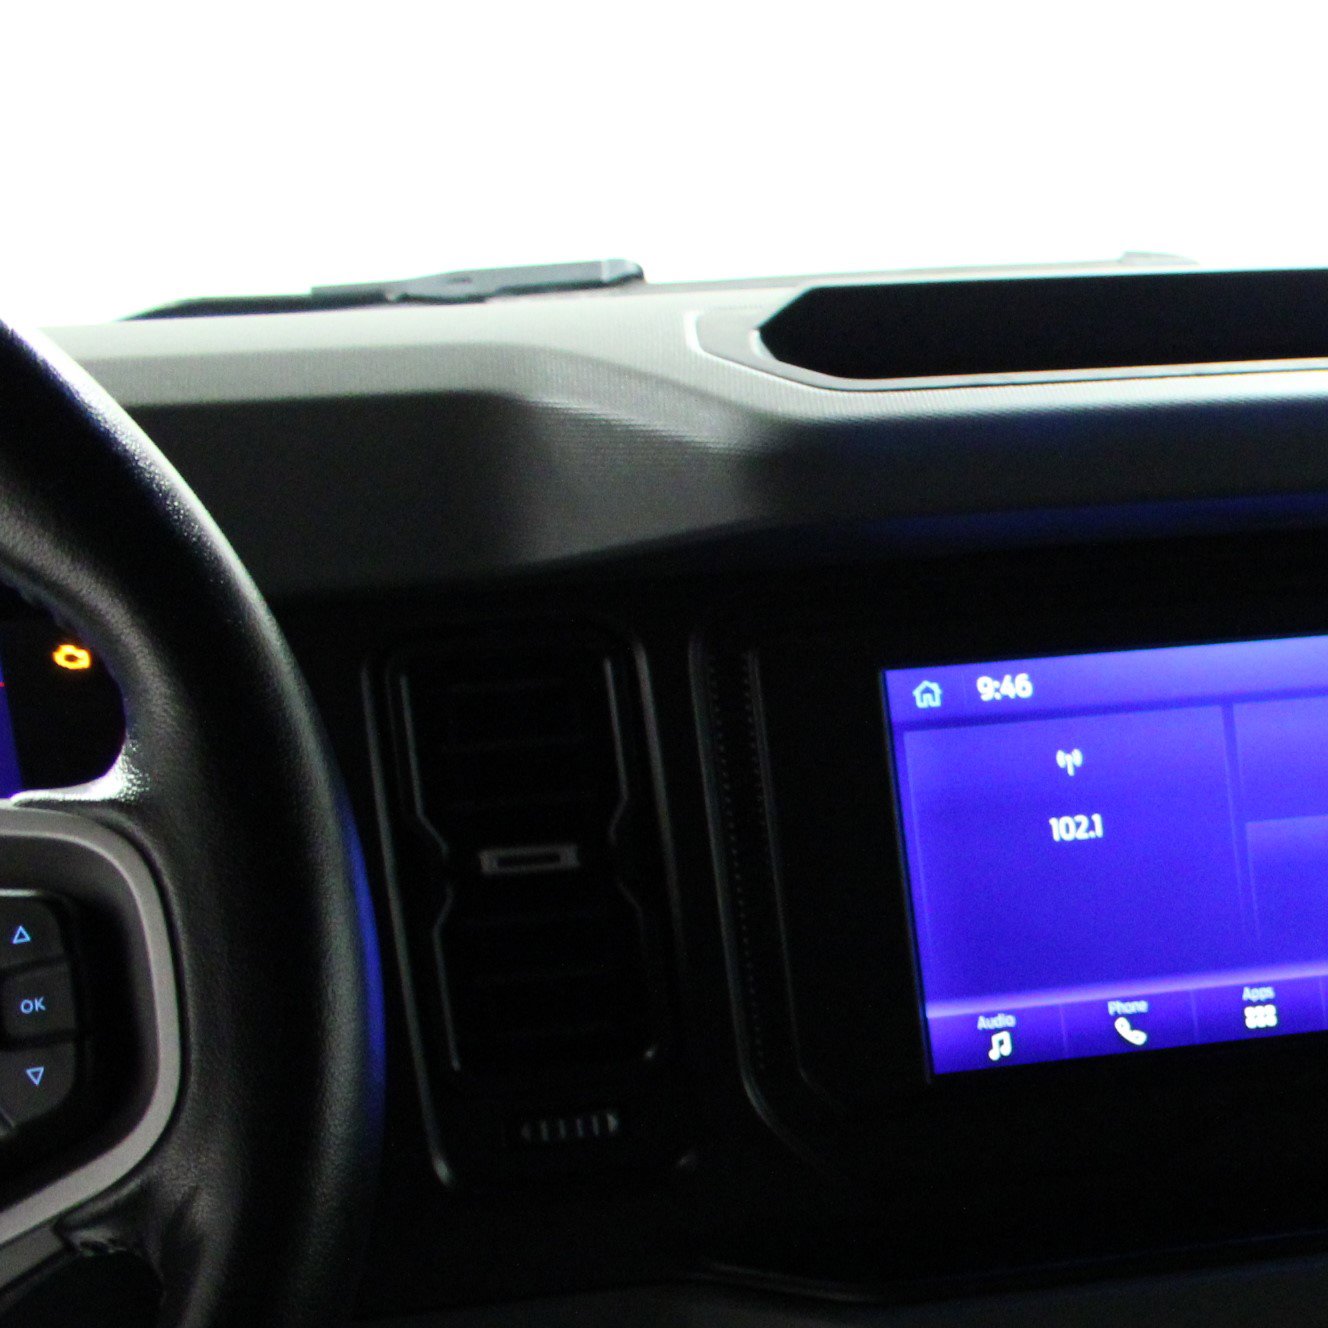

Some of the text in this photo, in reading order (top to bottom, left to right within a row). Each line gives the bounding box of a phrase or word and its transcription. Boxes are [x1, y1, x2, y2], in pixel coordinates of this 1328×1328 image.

[976, 672, 1034, 702] 9:46
[1049, 812, 1104, 842] 102.1
[1242, 986, 1275, 1004] Apps
[20, 996, 46, 1015] OK
[1107, 1000, 1148, 1017] Phone
[977, 1013, 1016, 1030] Audio
